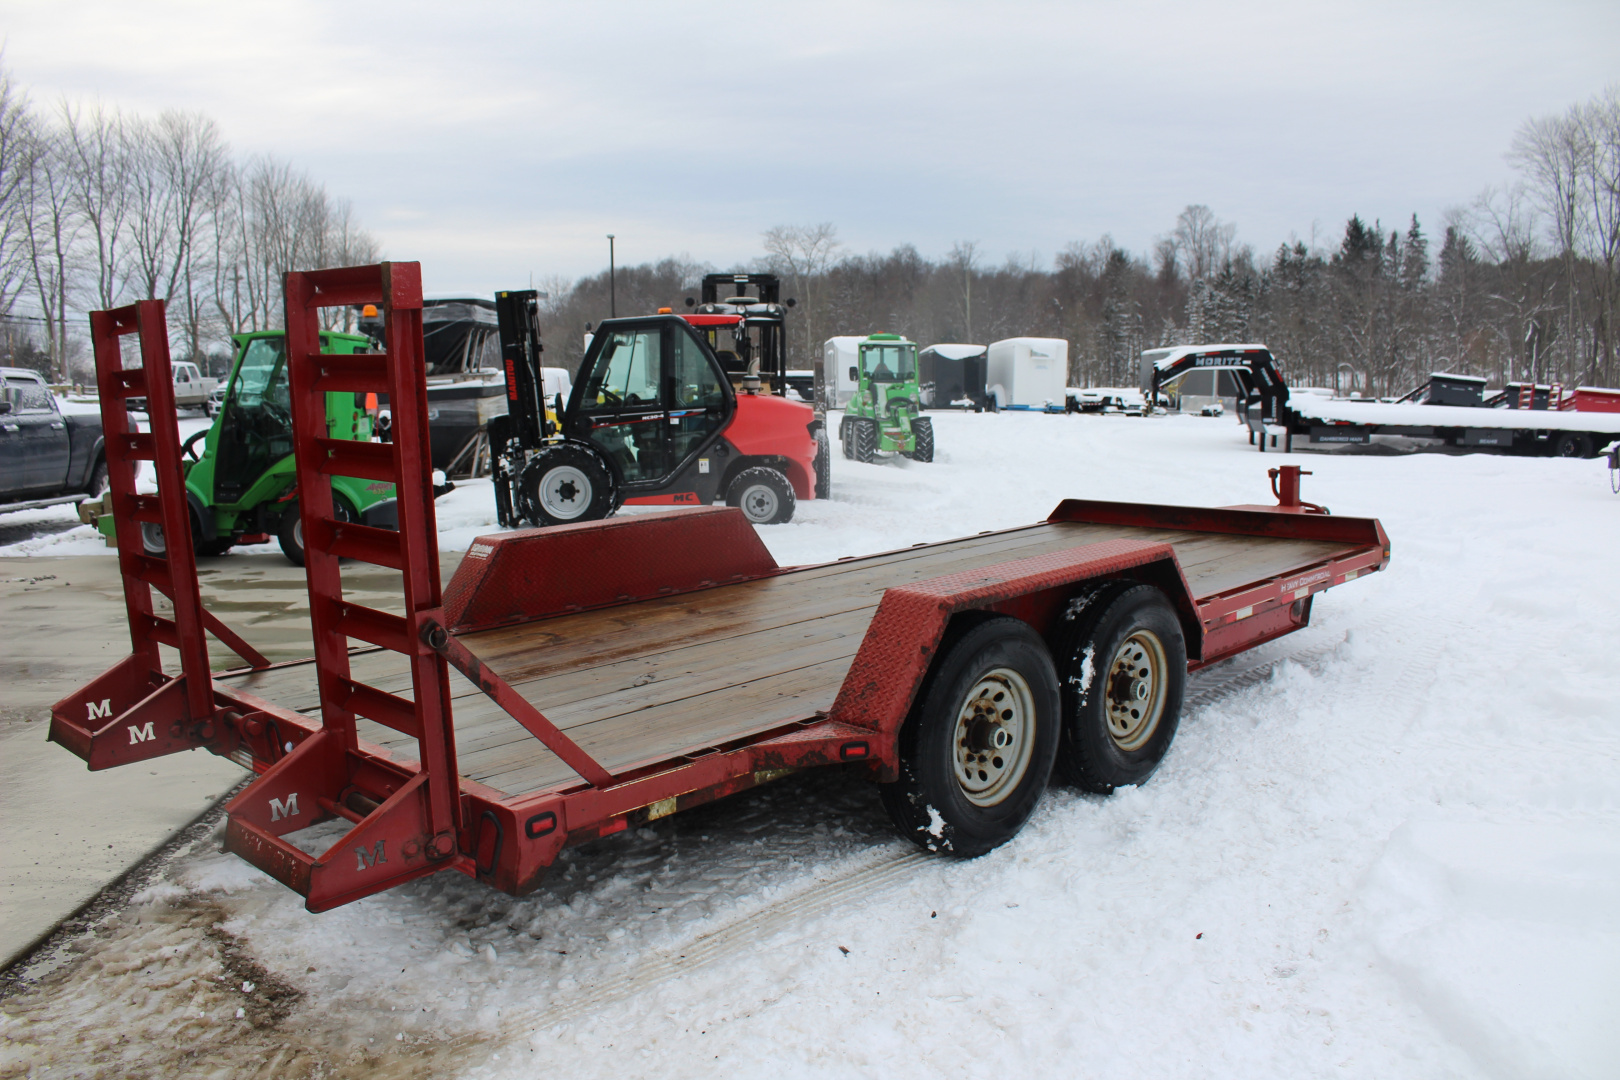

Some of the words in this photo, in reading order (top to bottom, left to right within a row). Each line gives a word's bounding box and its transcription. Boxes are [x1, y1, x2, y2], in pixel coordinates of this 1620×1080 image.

[1195, 357, 1242, 366] MORITZ
[505, 359, 518, 401] MANITOU
[673, 493, 694, 503] MC
[1281, 580, 1299, 592] HEAVY
[1299, 570, 1331, 586] COMMERCIAL
[86, 698, 113, 721] M
[128, 721, 157, 745] M
[268, 792, 300, 823] M
[354, 839, 387, 872] M
